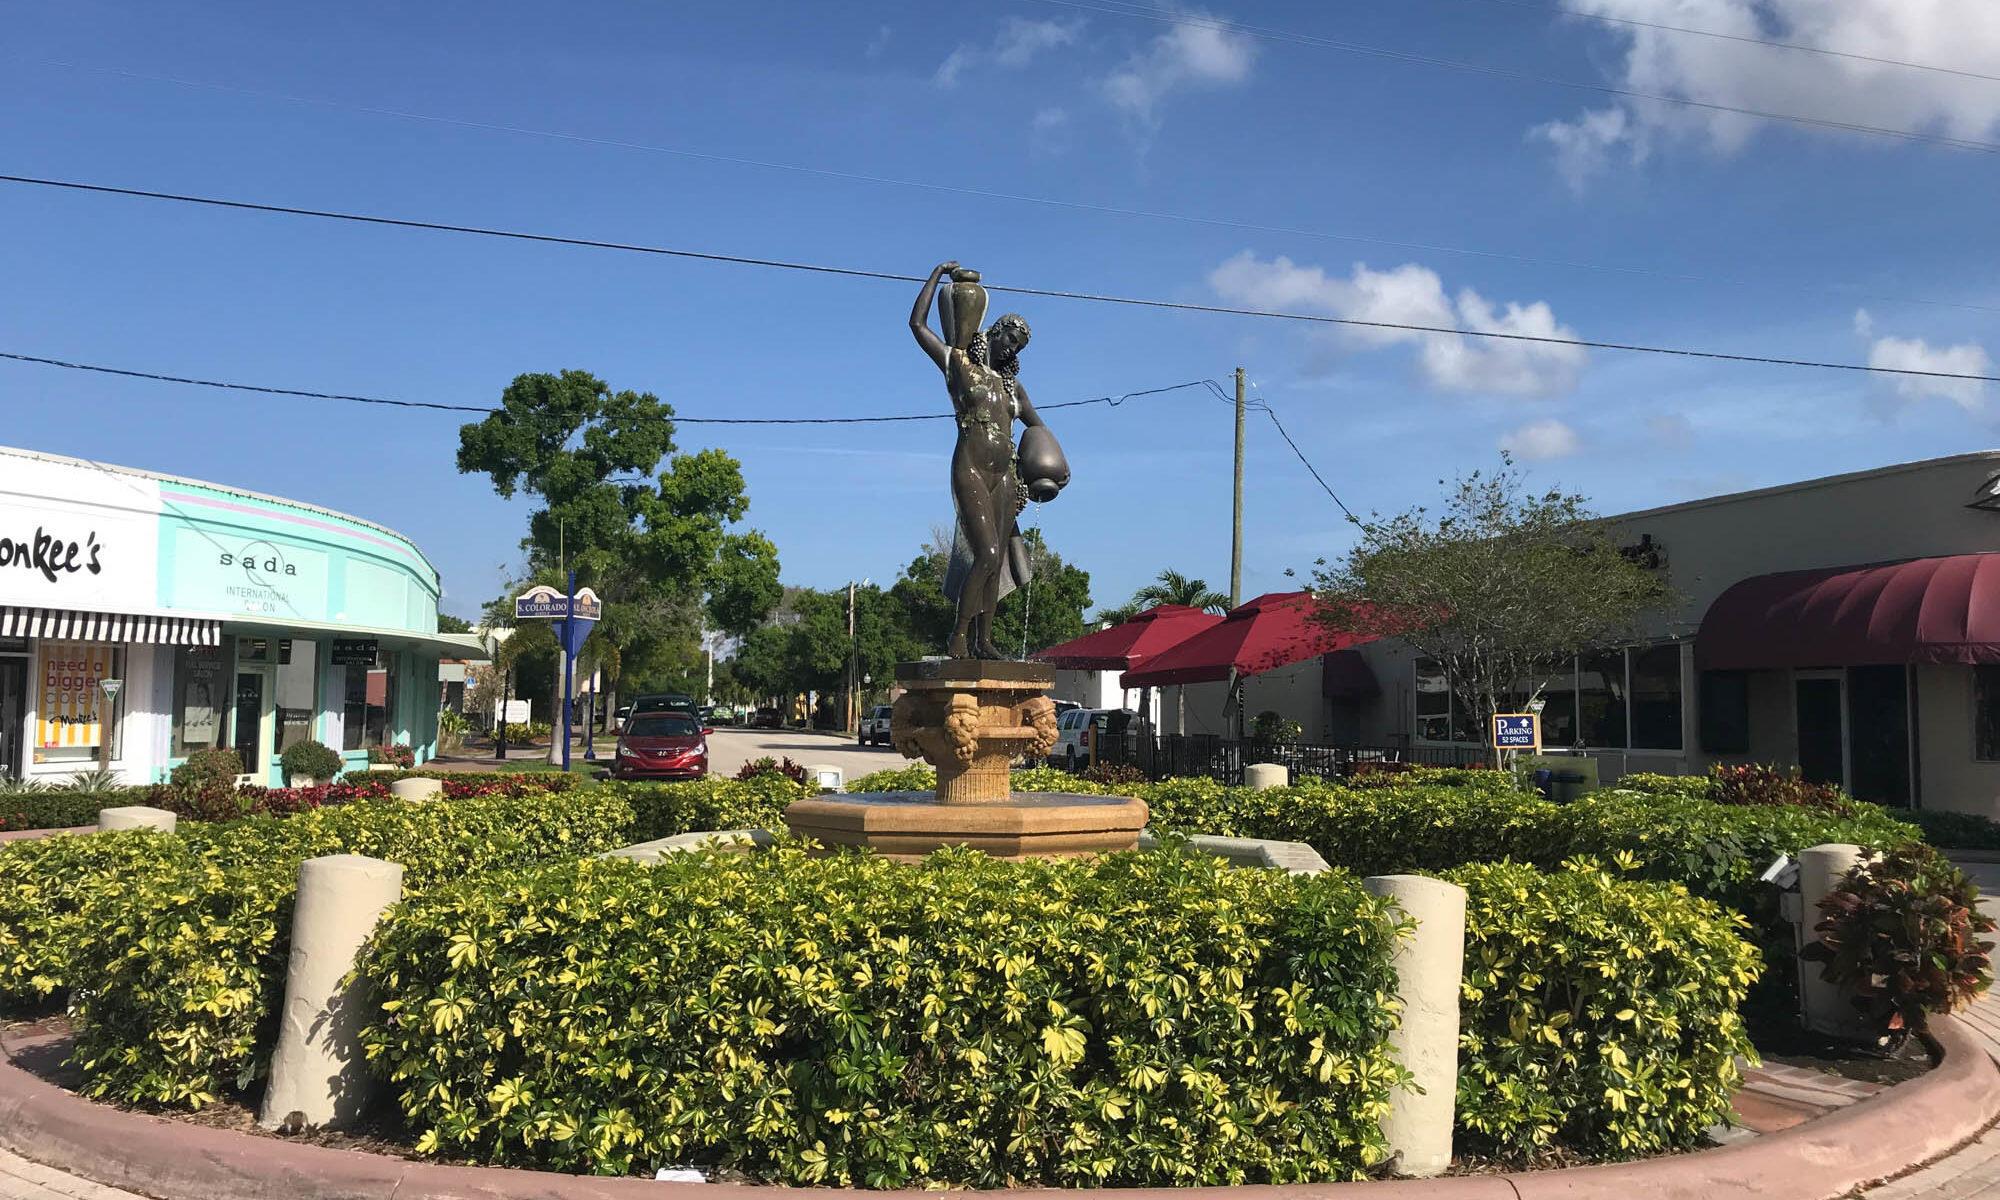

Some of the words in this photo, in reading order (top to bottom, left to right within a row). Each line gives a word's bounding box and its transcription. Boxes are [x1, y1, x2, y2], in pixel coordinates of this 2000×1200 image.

[220, 553, 296, 576] sada
[226, 585, 289, 602] INTERNATIONAL
[525, 604, 567, 612] COLORADO
[47, 659, 87, 671] need
[94, 662, 103, 672] a
[46, 672, 101, 691] bigger
